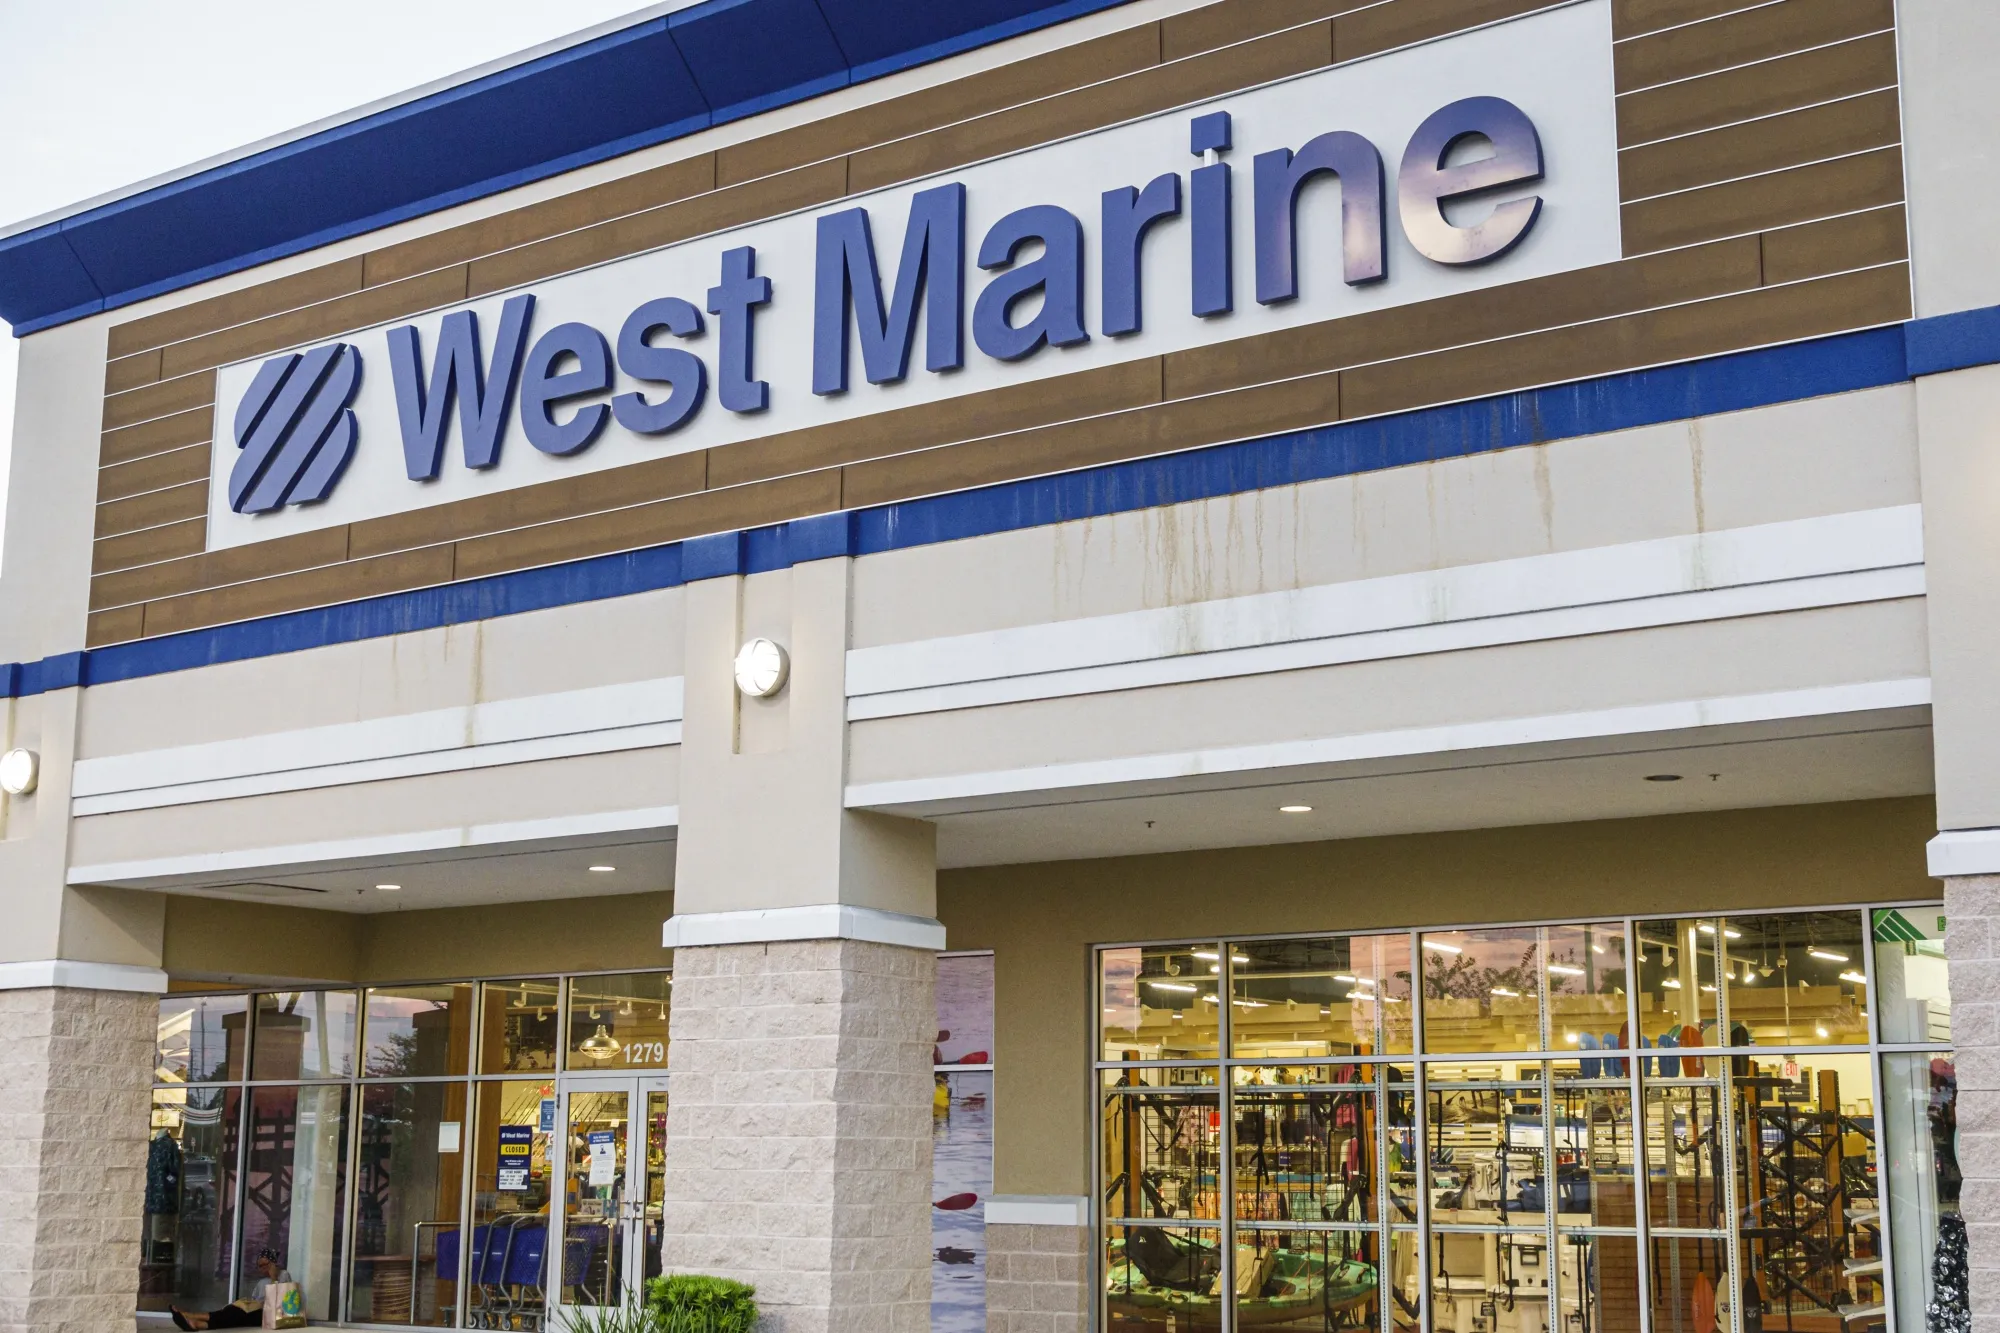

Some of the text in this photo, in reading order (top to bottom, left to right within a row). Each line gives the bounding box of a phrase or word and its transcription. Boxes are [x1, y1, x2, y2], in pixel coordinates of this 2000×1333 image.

[386, 95, 1545, 482] West Marine
[623, 1042, 664, 1063] 1279
[1785, 1063, 1798, 1076] EXIT
